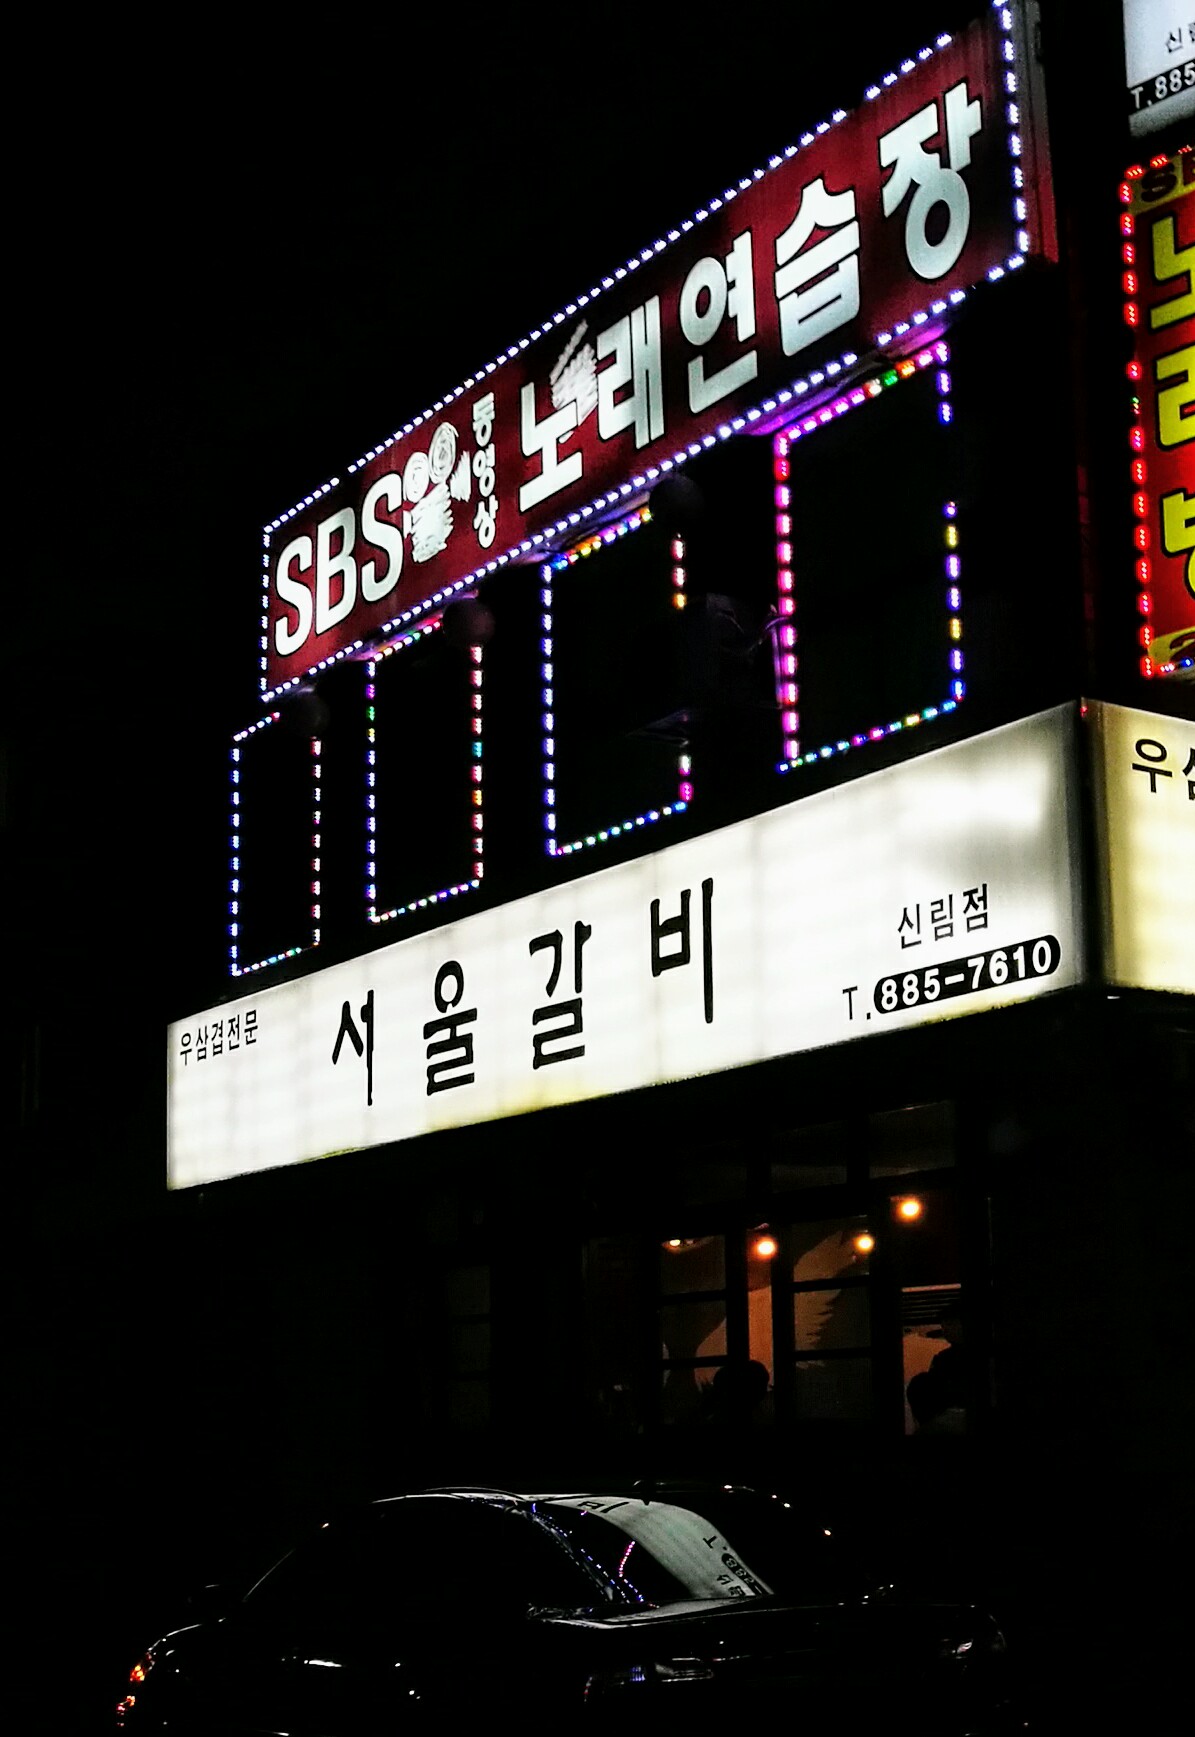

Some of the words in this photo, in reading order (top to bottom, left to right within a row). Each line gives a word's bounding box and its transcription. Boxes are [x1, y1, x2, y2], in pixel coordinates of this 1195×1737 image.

[274, 472, 403, 658] SBS
[519, 81, 982, 513] 노래연습장
[897, 883, 990, 950] 신림점
[331, 877, 714, 1107] 서울갈비
[842, 939, 1053, 1021] T.885-7610
[178, 1009, 259, 1067] 우삼겹전문
